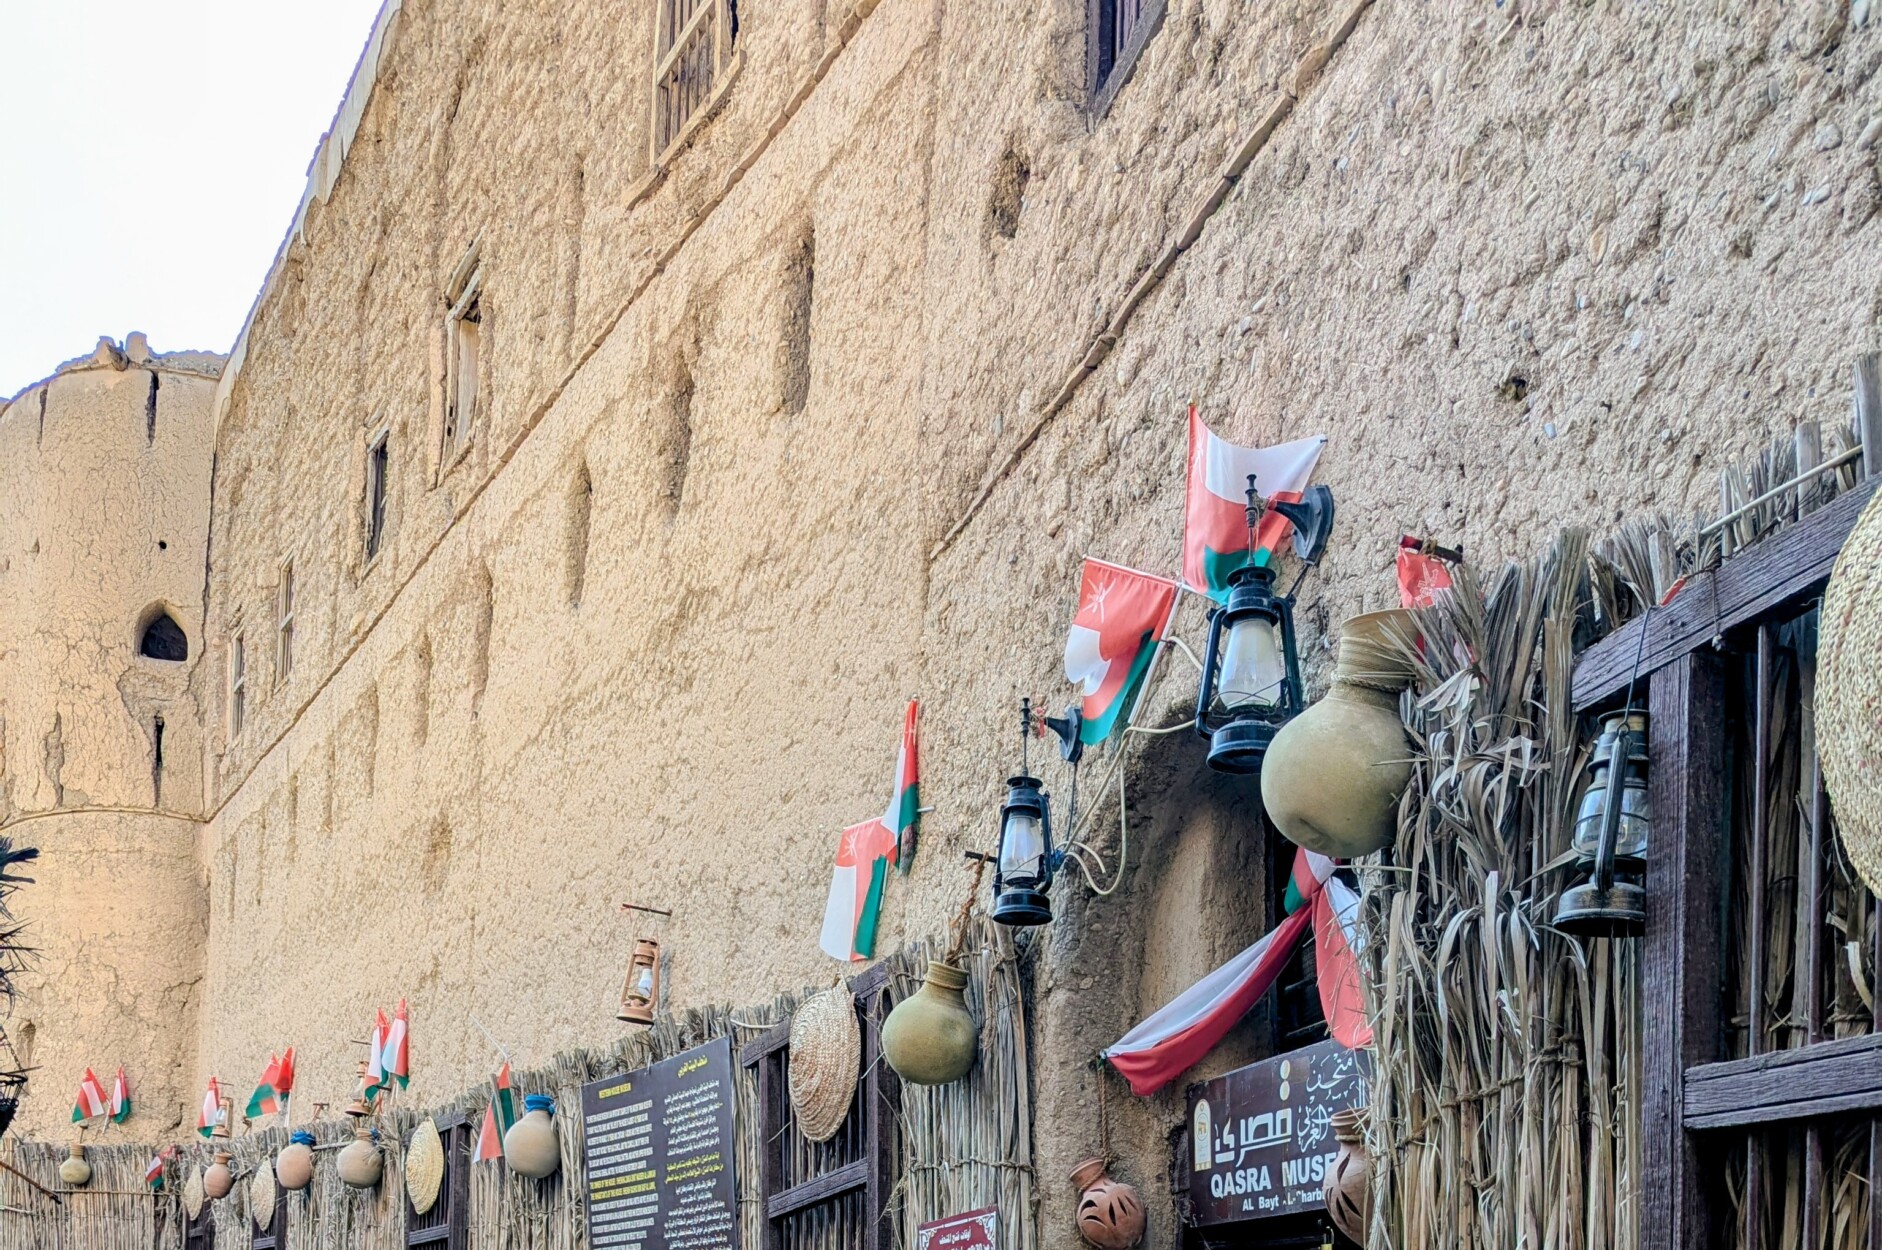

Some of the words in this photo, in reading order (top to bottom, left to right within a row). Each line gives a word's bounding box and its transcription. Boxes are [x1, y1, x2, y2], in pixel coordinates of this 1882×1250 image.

[1211, 1165, 1272, 1199] QASRA
[1242, 1197, 1255, 1212] AL
[1258, 1194, 1280, 1212] Bayt
